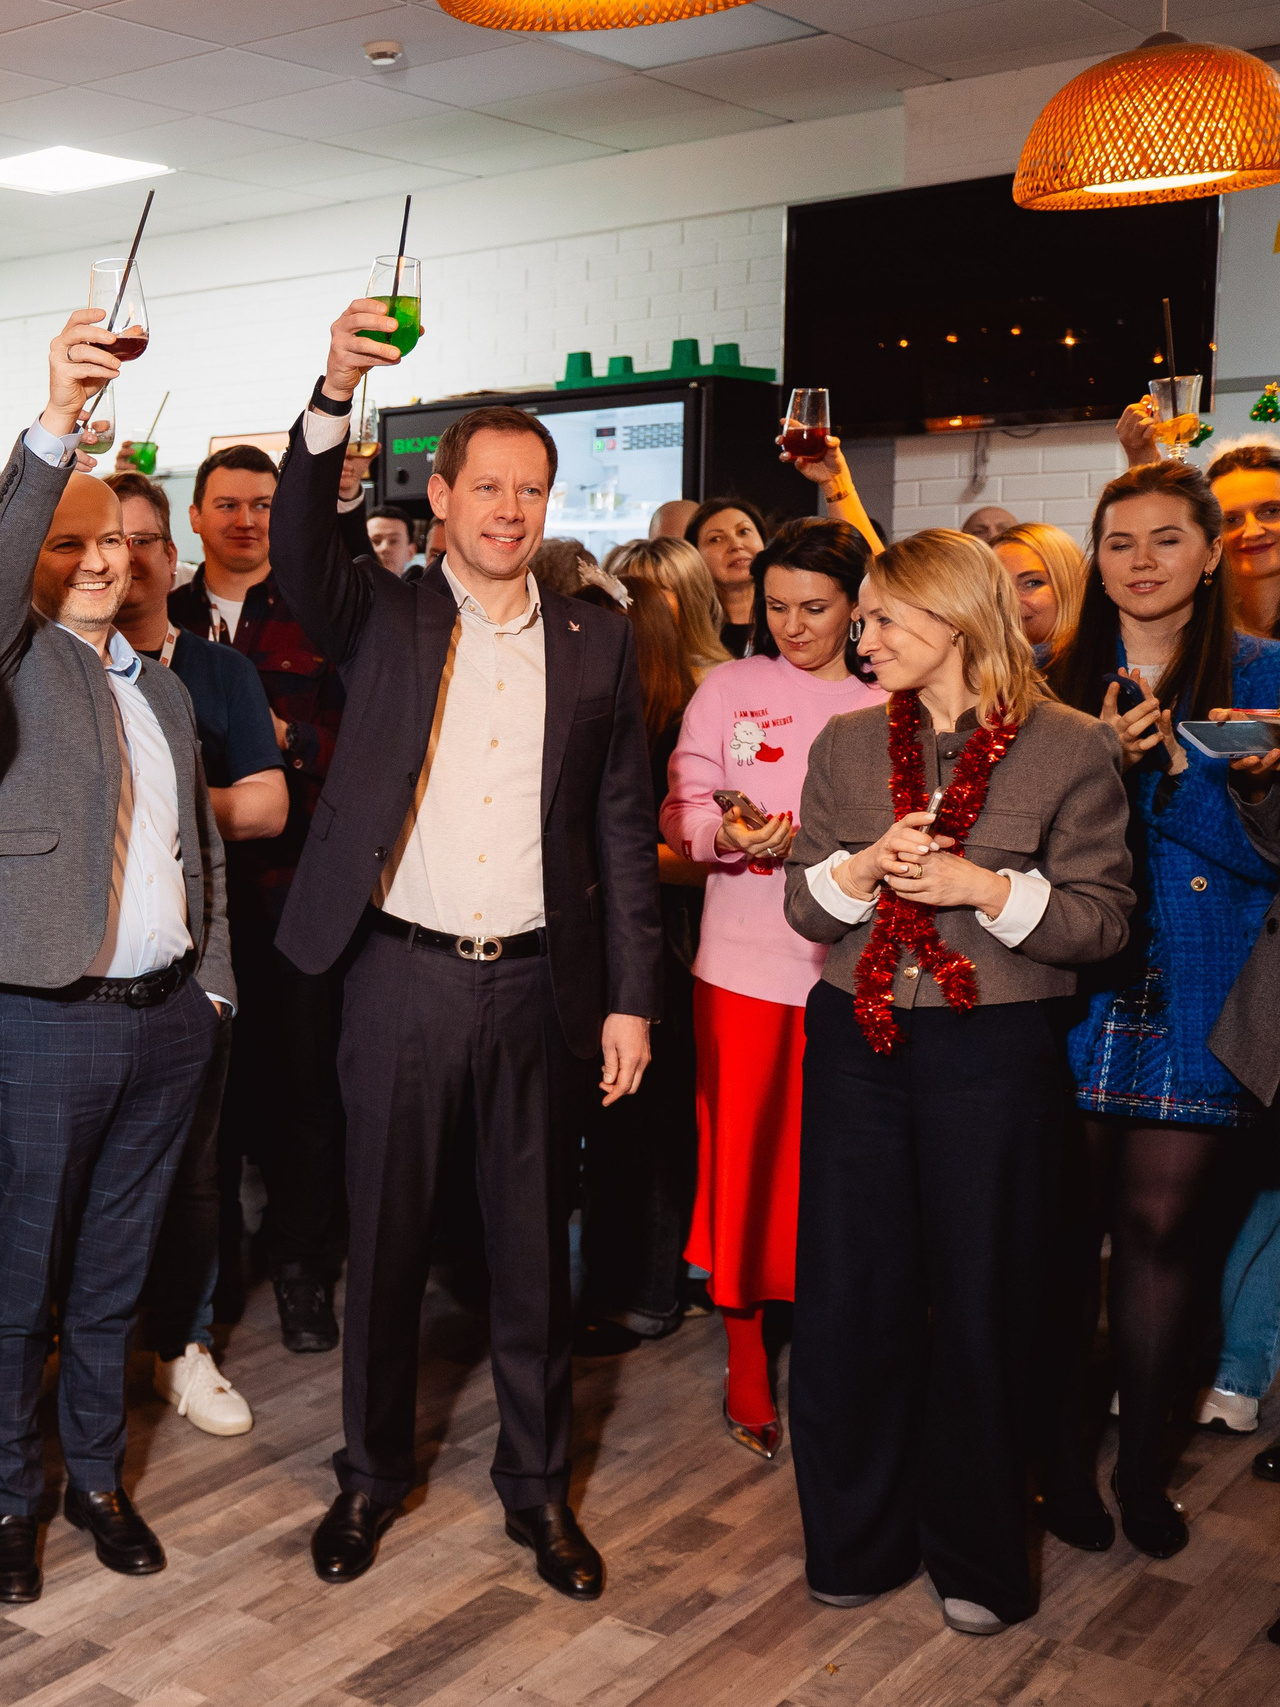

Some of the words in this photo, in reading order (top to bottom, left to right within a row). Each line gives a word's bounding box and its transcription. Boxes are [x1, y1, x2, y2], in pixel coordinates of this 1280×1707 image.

[392, 436, 441, 455] ВКУС
[749, 708, 769, 718] WHERE
[761, 720, 770, 729] AM
[772, 715, 793, 727] NEEDED
